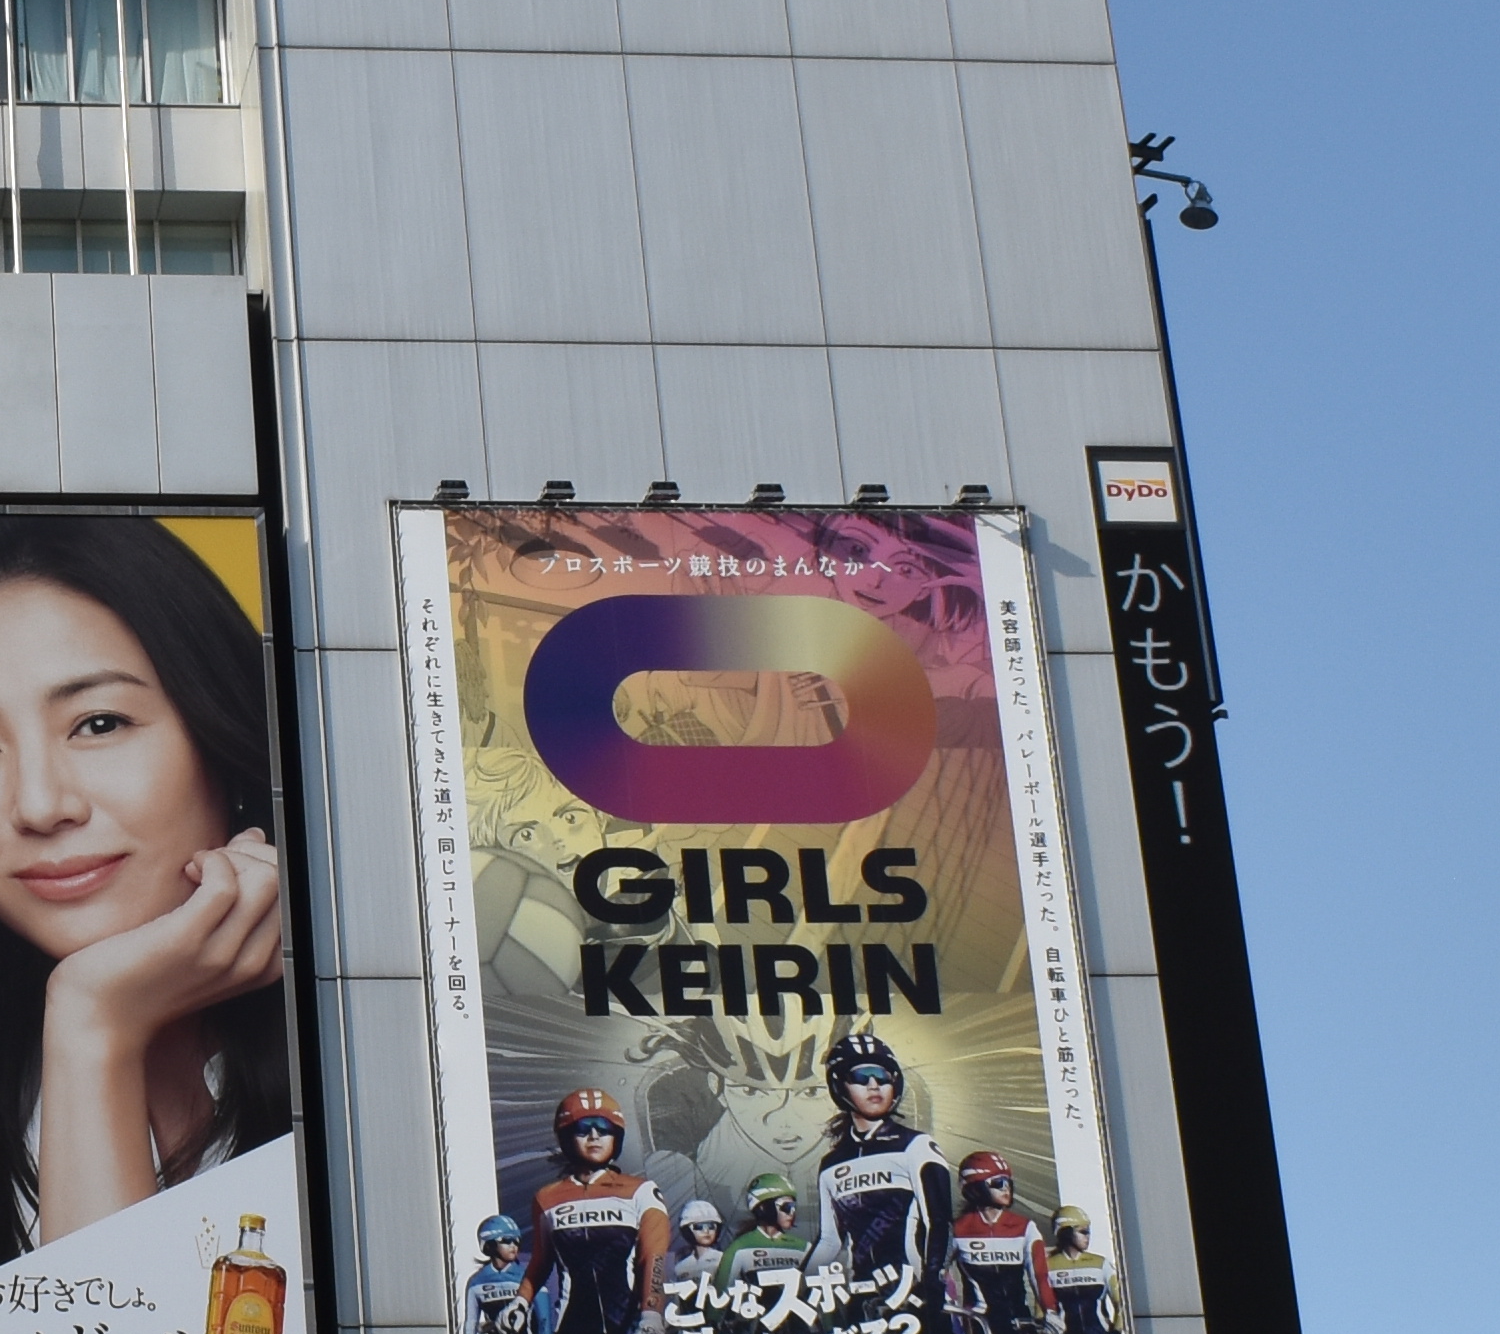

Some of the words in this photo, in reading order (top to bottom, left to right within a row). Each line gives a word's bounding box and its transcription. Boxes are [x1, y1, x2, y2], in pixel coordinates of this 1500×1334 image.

[1106, 480, 1168, 501] DyDo
[538, 553, 893, 578] プロスポーツ競技のまんなかへ
[572, 847, 929, 925] GIRLS
[579, 943, 942, 1017] KEIRIN
[835, 1170, 893, 1195] KEIRIN
[556, 1209, 624, 1229] KEIRIN
[969, 1249, 1021, 1263] KEIRIN
